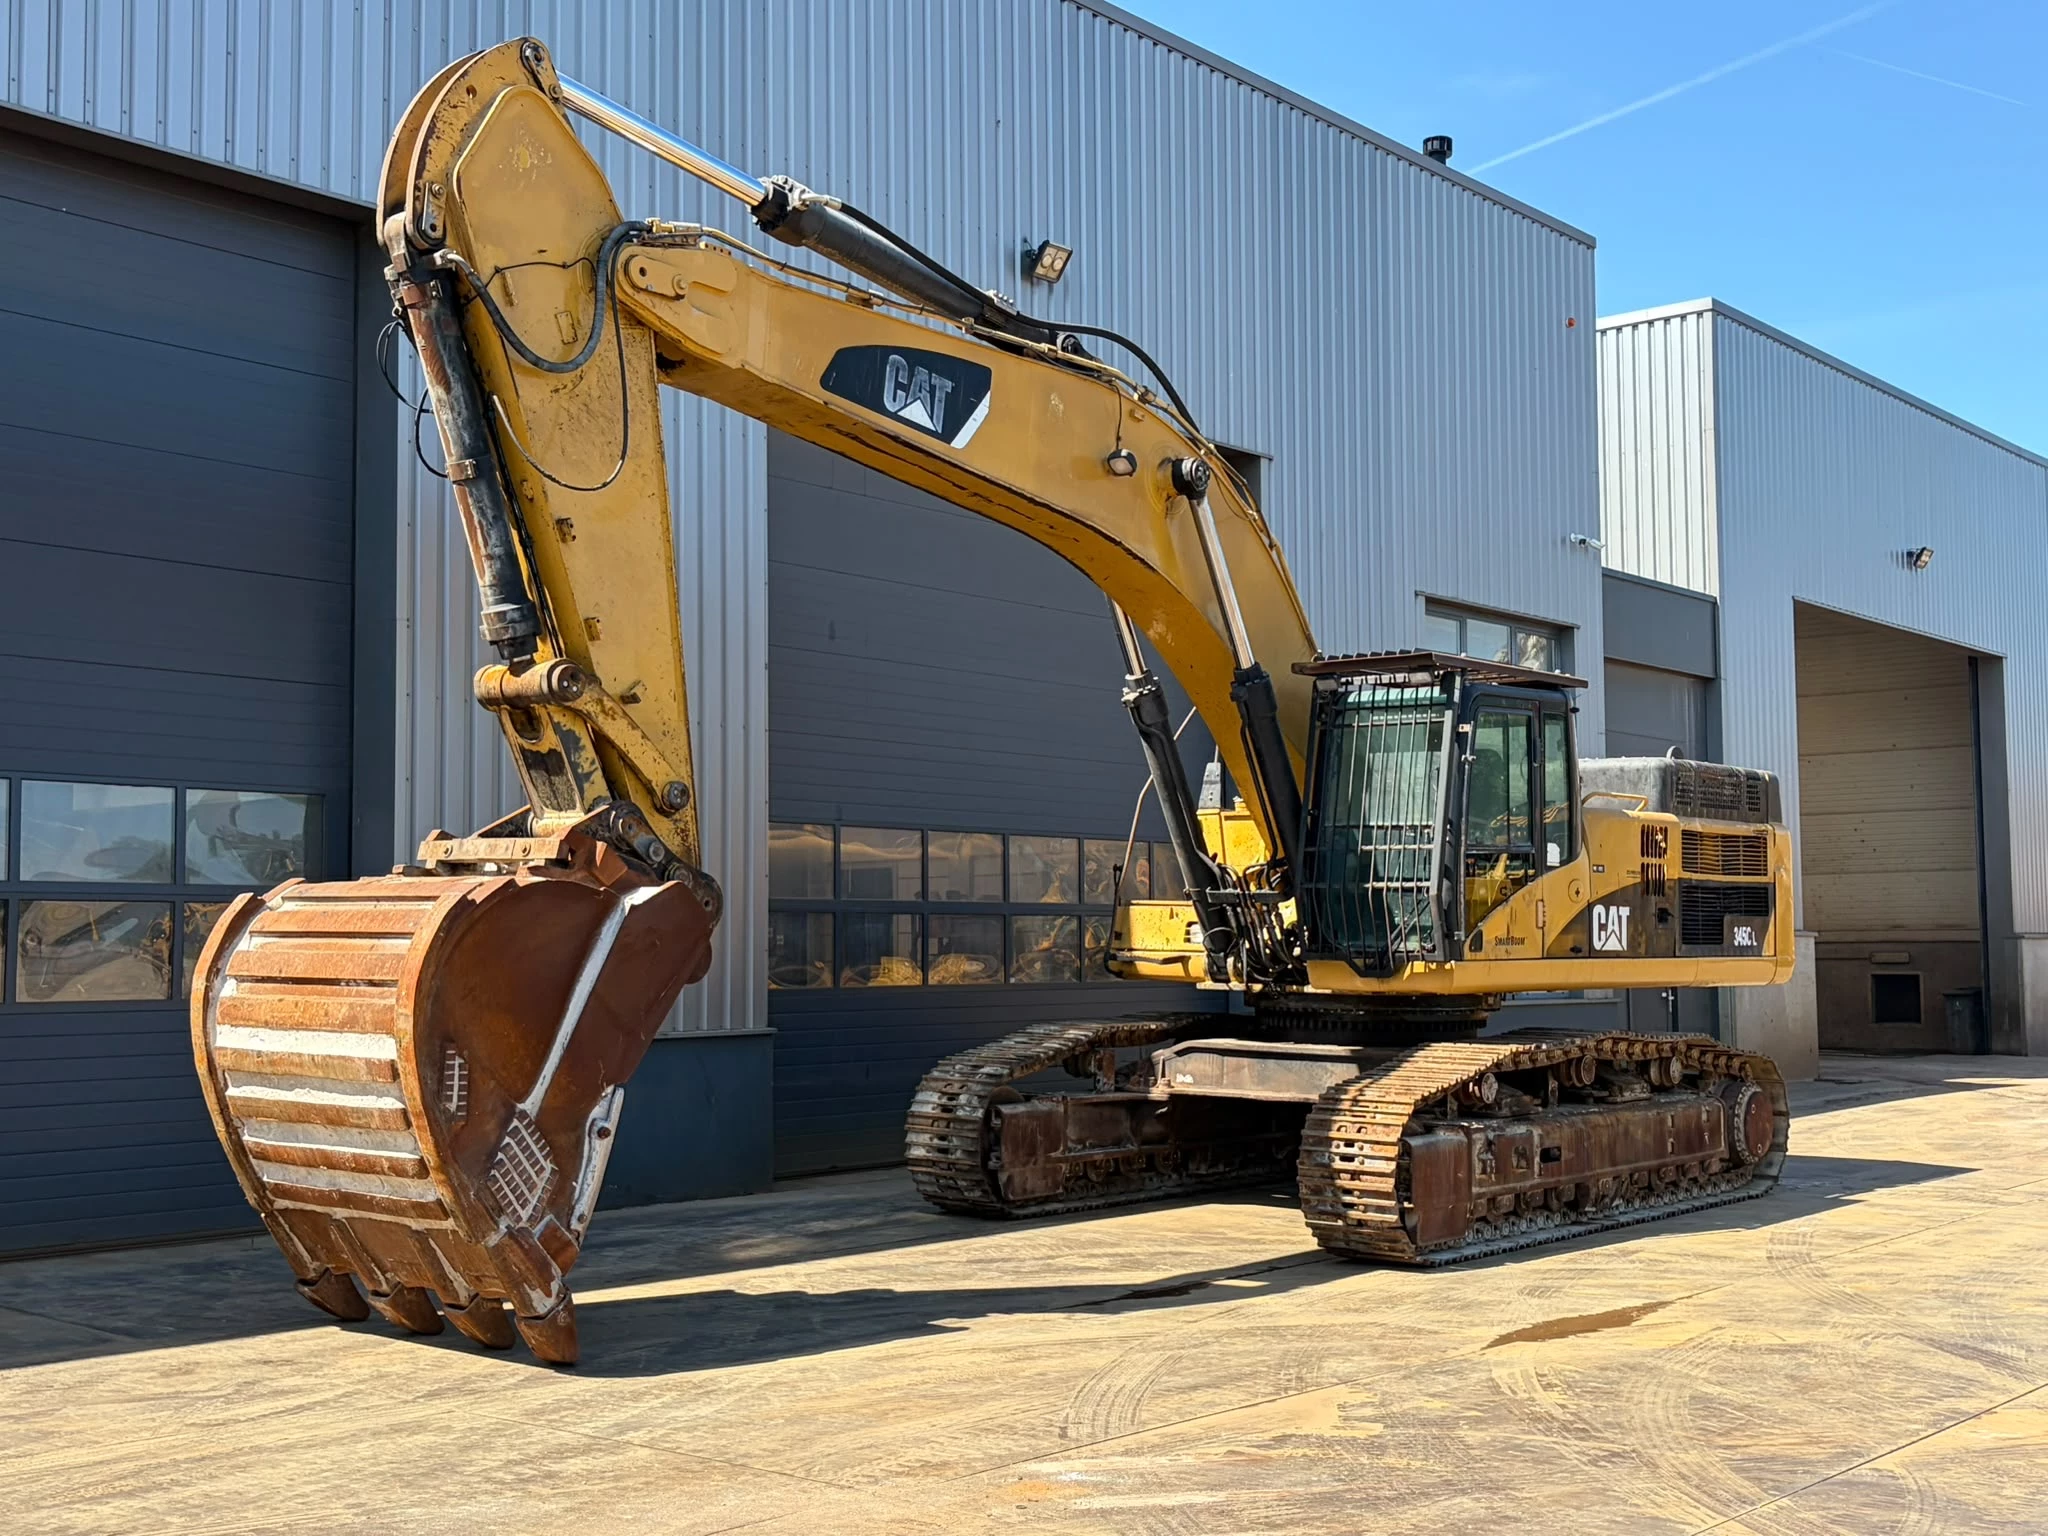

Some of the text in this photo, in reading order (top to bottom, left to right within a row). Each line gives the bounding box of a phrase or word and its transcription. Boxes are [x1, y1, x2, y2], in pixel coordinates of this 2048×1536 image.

[884, 354, 953, 434] CAT
[1592, 904, 1630, 951] CAT
[1733, 926, 1751, 946] 345C
